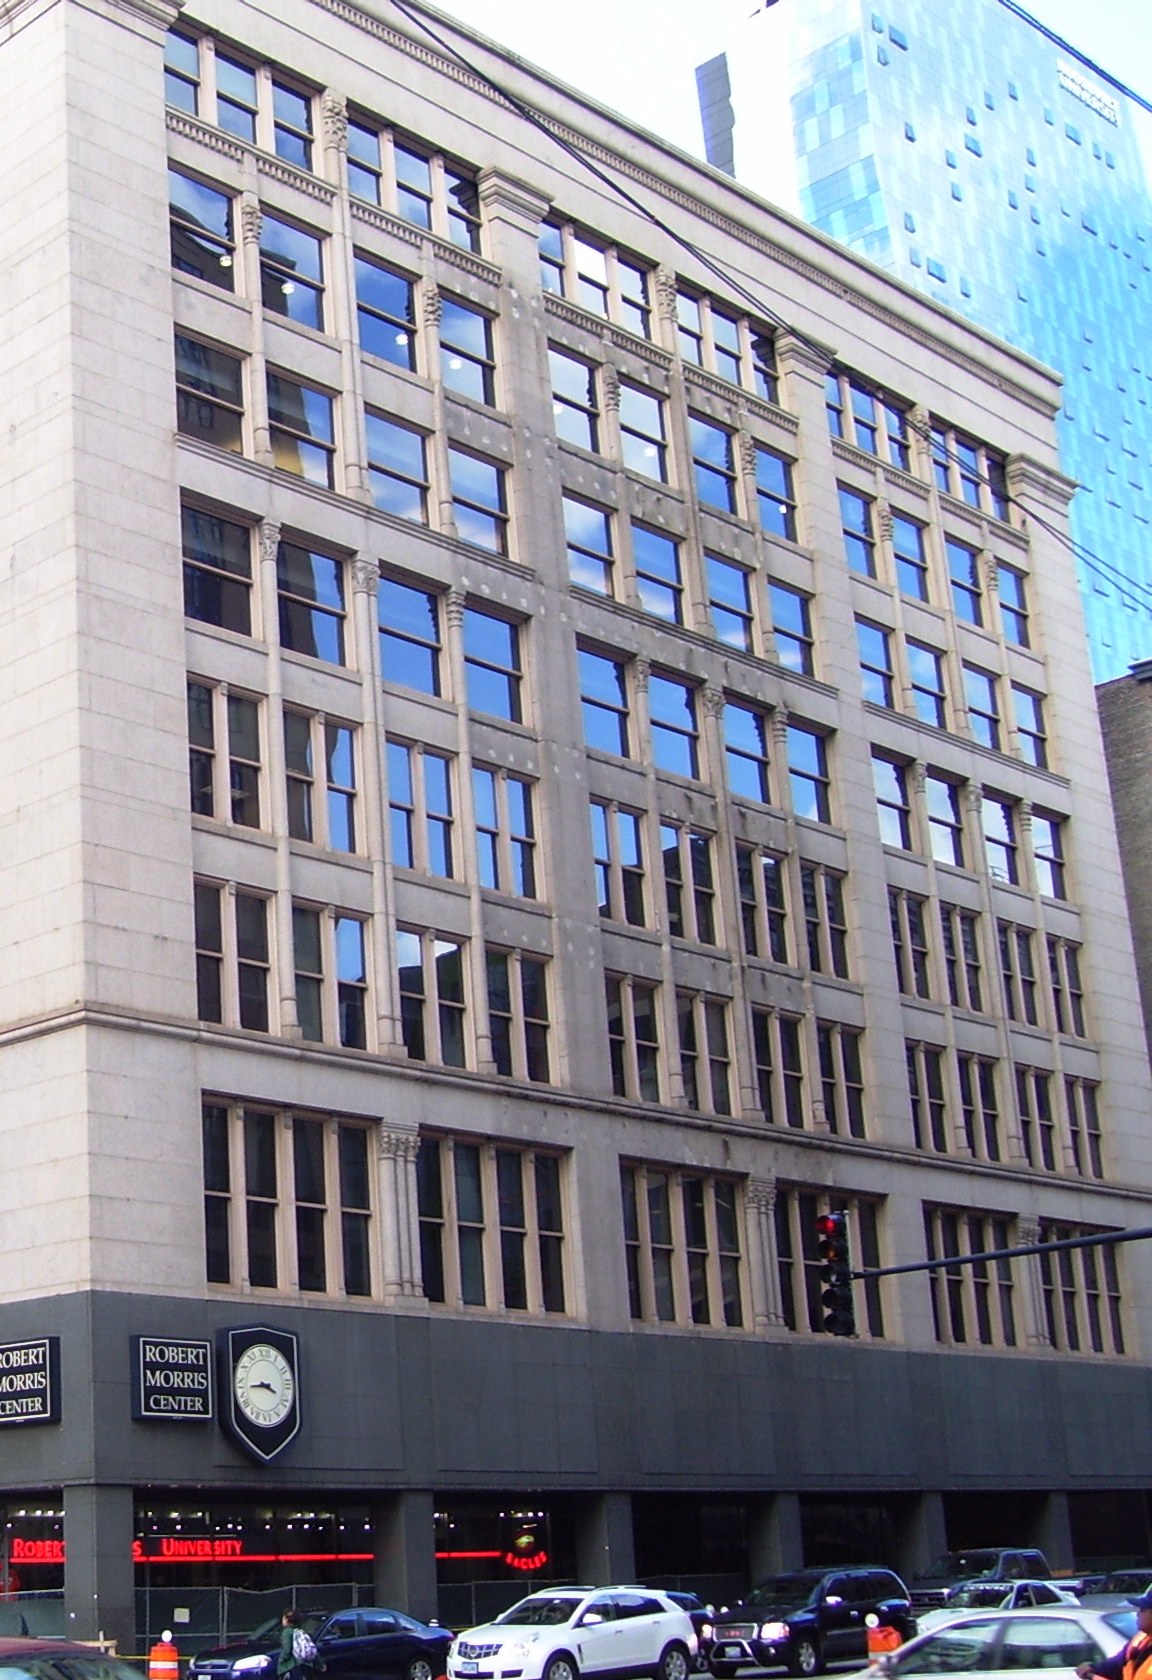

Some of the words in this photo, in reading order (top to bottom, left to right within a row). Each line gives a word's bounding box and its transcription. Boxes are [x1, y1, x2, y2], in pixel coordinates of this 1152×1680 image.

[144, 1344, 206, 1365] ROBERT
[145, 1369, 207, 1389] MORRIS
[149, 1394, 204, 1411] CENTER
[12, 1538, 66, 1558] ROBER
[161, 1537, 242, 1556] UNIVERSITY
